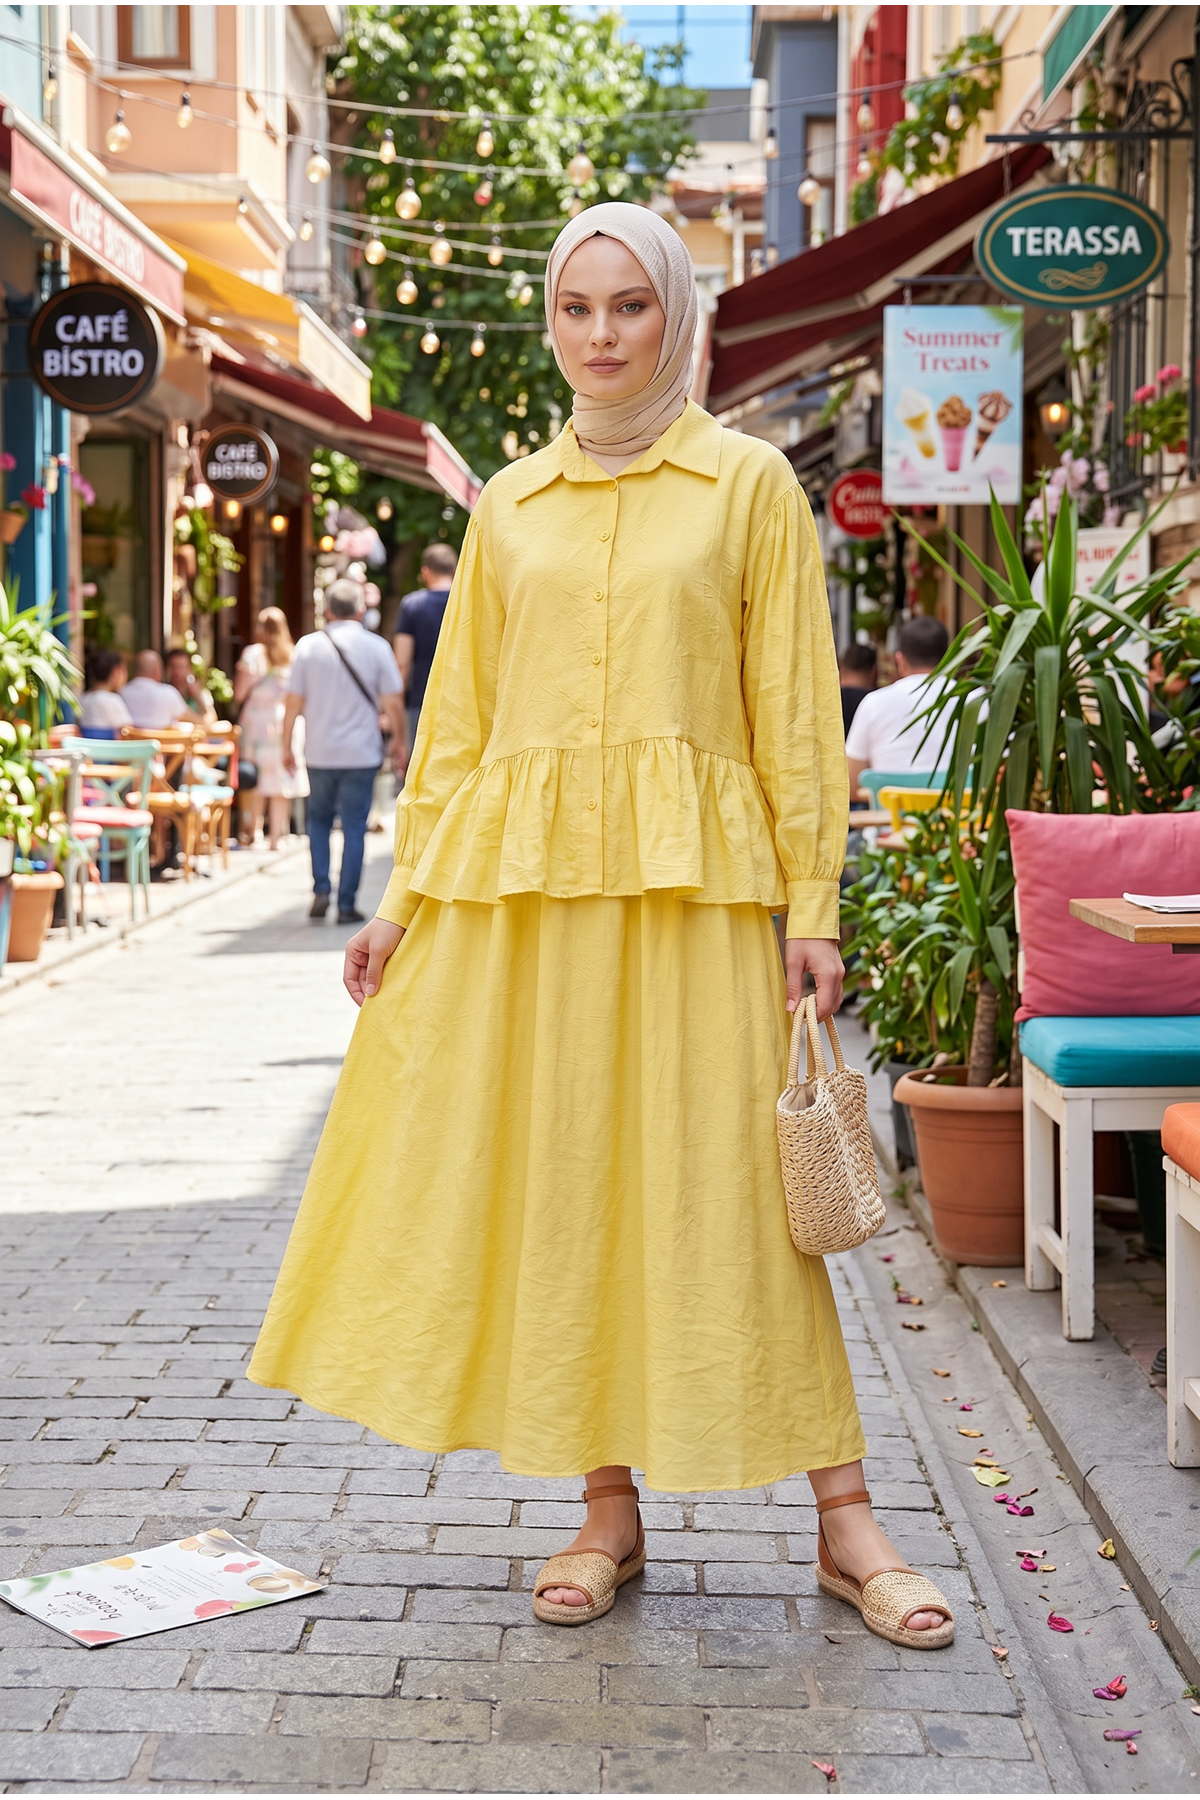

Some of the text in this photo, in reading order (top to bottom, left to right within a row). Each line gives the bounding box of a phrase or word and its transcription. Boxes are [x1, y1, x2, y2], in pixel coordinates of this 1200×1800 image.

[1006, 225, 1142, 257] TERASSA
[55, 308, 130, 343] CAFÉ
[903, 327, 1005, 348] Summer
[914, 351, 991, 372] Treats
